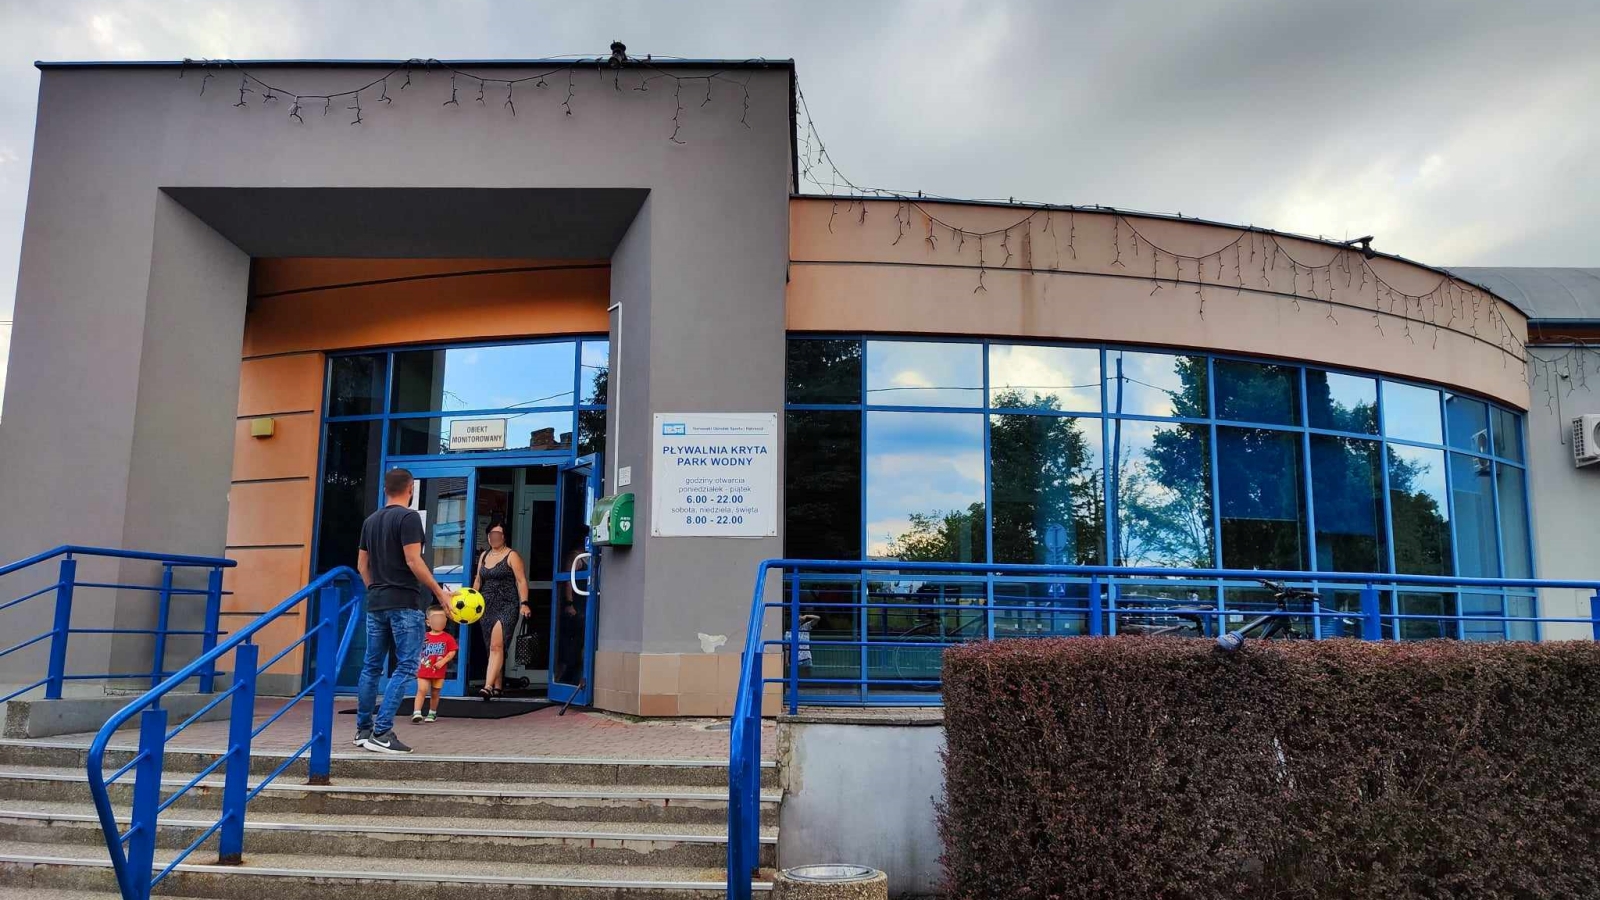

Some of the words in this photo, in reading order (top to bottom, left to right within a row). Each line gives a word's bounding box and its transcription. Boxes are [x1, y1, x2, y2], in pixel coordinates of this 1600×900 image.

[452, 435, 502, 444] MONITOROWANY
[663, 446, 728, 454] PŁYWALNIA
[731, 446, 768, 454] KRYTA
[678, 458, 707, 466] PARK
[711, 458, 752, 466] WODNY
[686, 495, 707, 504] 6.00
[716, 495, 744, 504] 22.00
[686, 516, 707, 524] 8.00
[716, 516, 743, 524] 22.00
